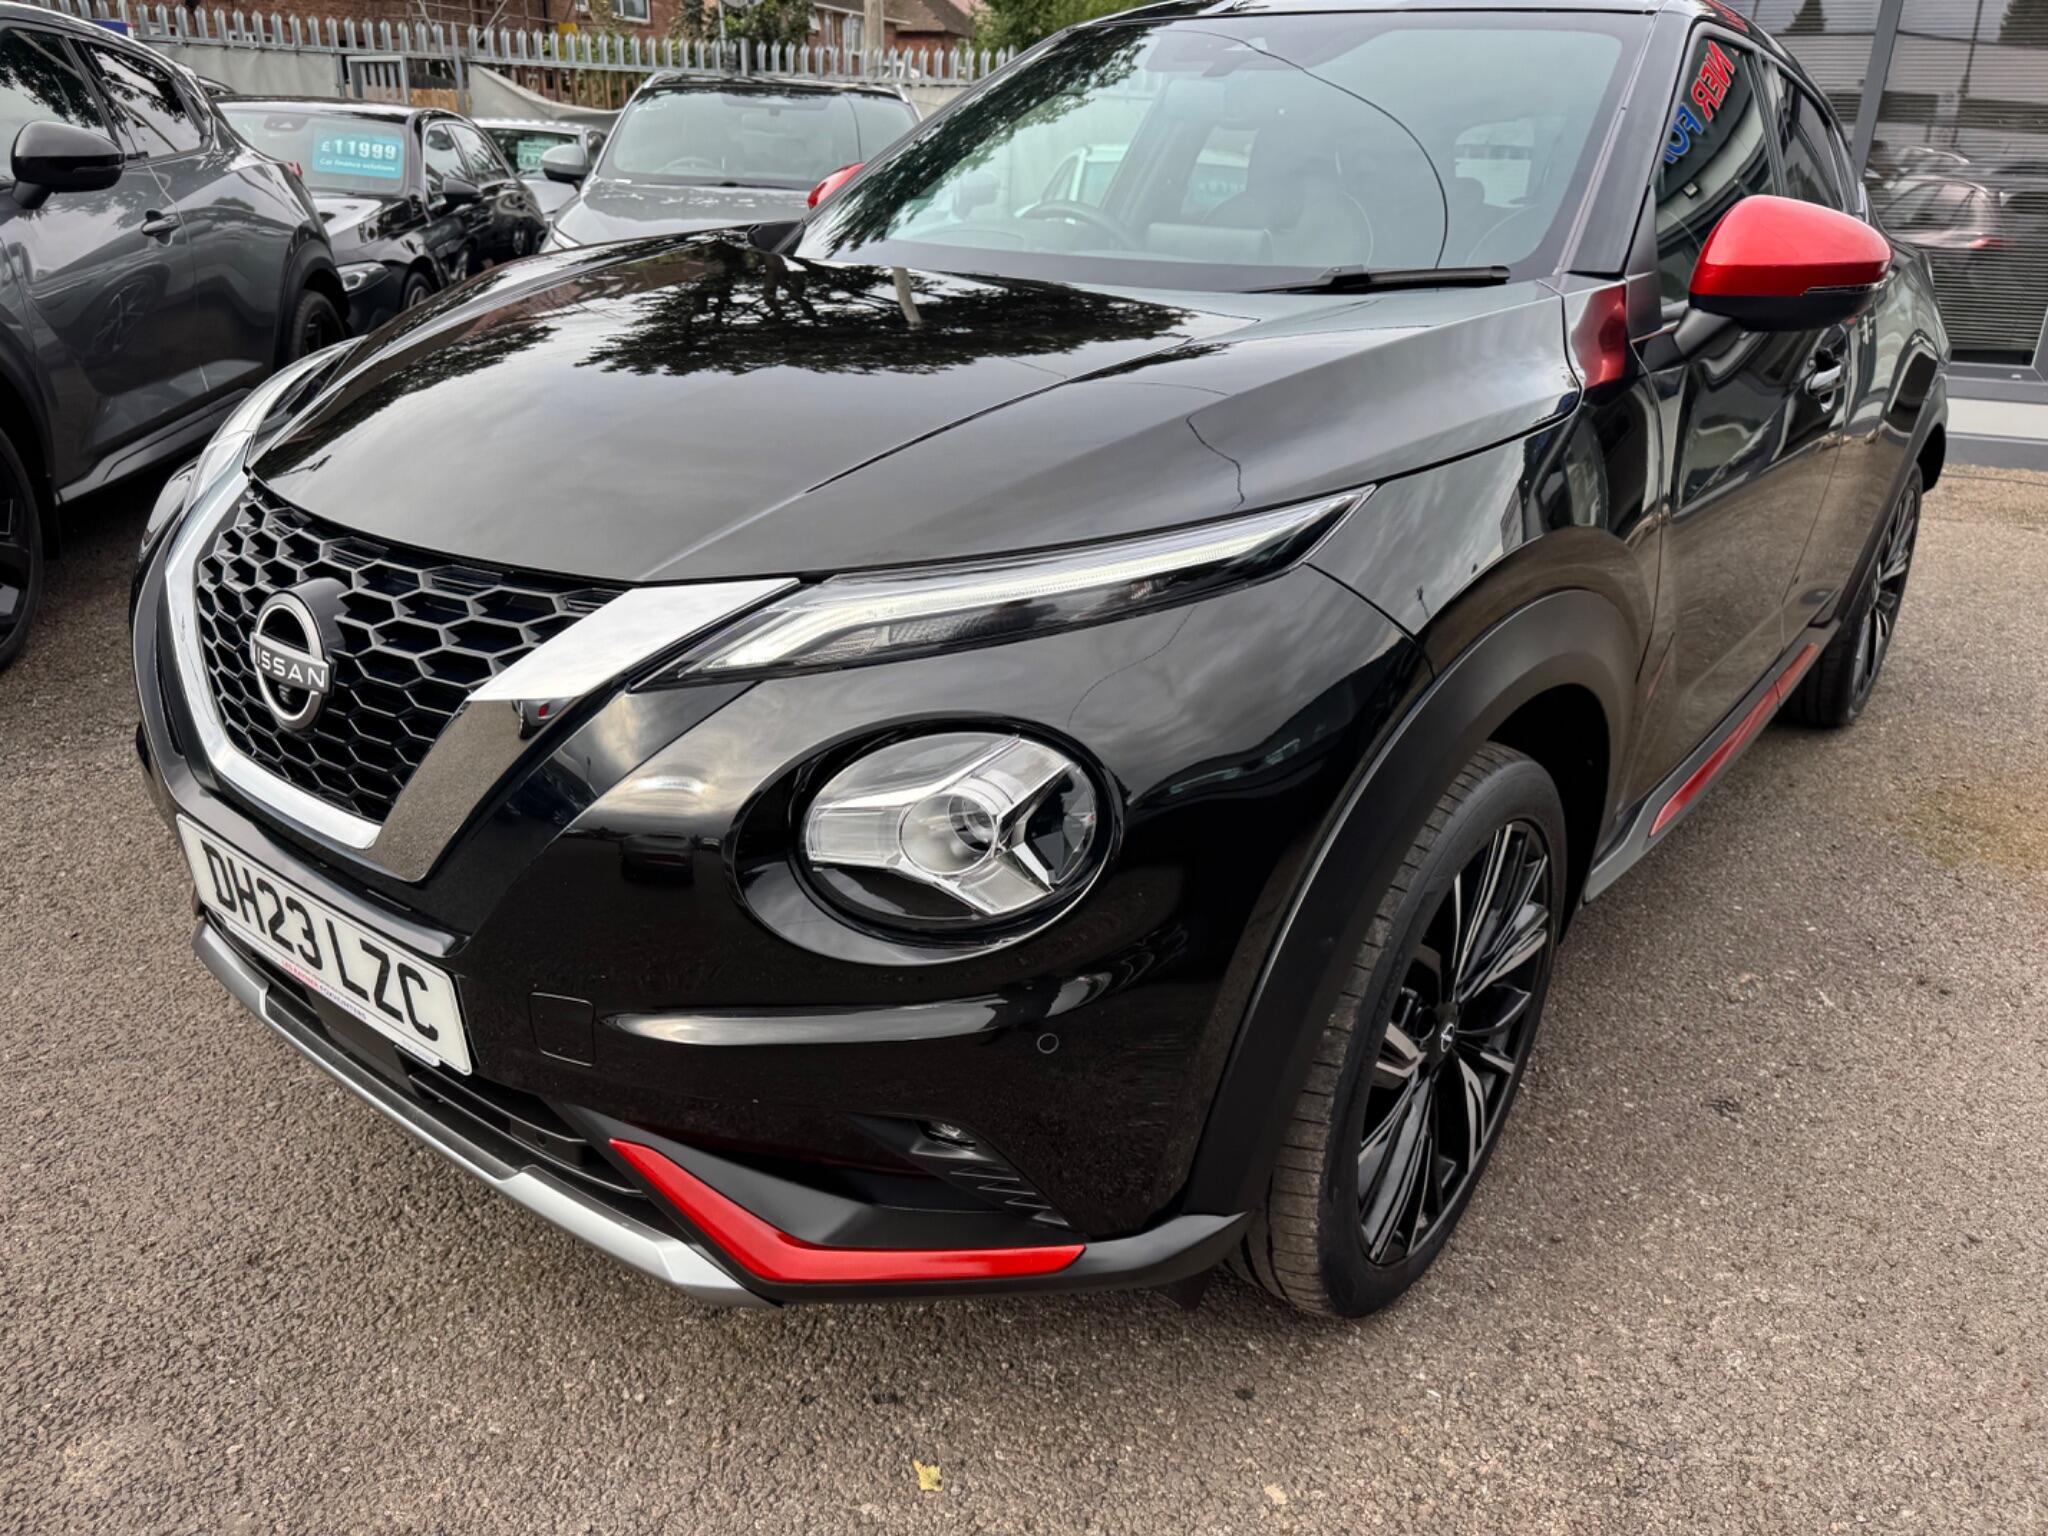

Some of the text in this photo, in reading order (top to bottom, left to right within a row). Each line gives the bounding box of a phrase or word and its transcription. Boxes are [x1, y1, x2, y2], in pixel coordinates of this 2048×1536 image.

[319, 158, 333, 166] Car
[334, 159, 361, 168] finance
[321, 138, 397, 160] £11999
[253, 641, 325, 688] ISSAN
[201, 839, 438, 1043] DH23 LZC
